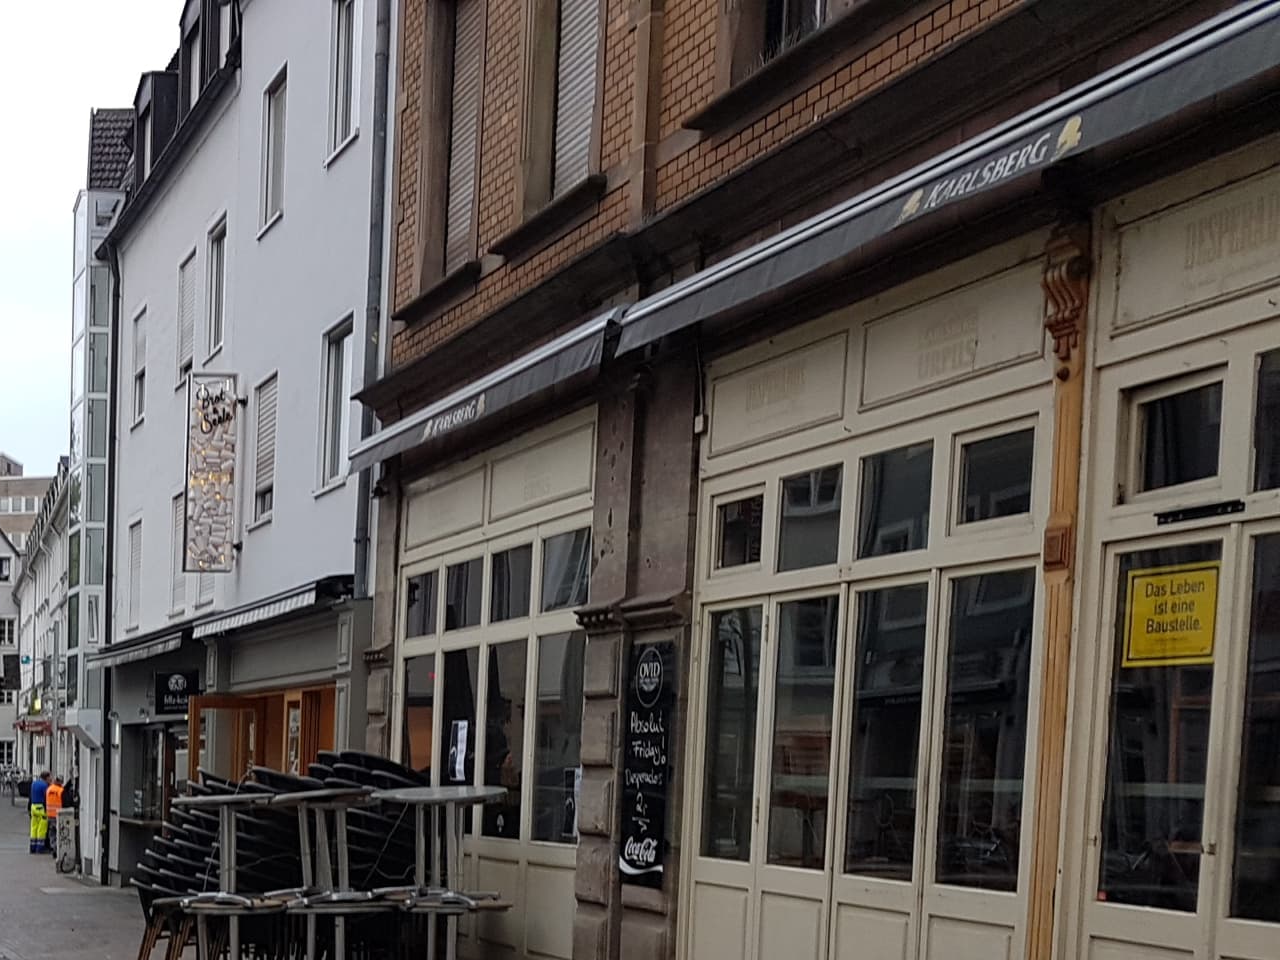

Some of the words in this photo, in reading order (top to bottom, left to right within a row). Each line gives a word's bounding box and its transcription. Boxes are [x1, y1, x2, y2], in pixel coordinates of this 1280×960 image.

[924, 133, 1051, 209] KARLSBERG
[196, 387, 226, 410] Brot
[1145, 583, 1167, 598] Das
[1170, 580, 1205, 595] Leben
[1154, 600, 1168, 616] ist
[1171, 600, 1195, 614] eine
[640, 662, 660, 677] OVID
